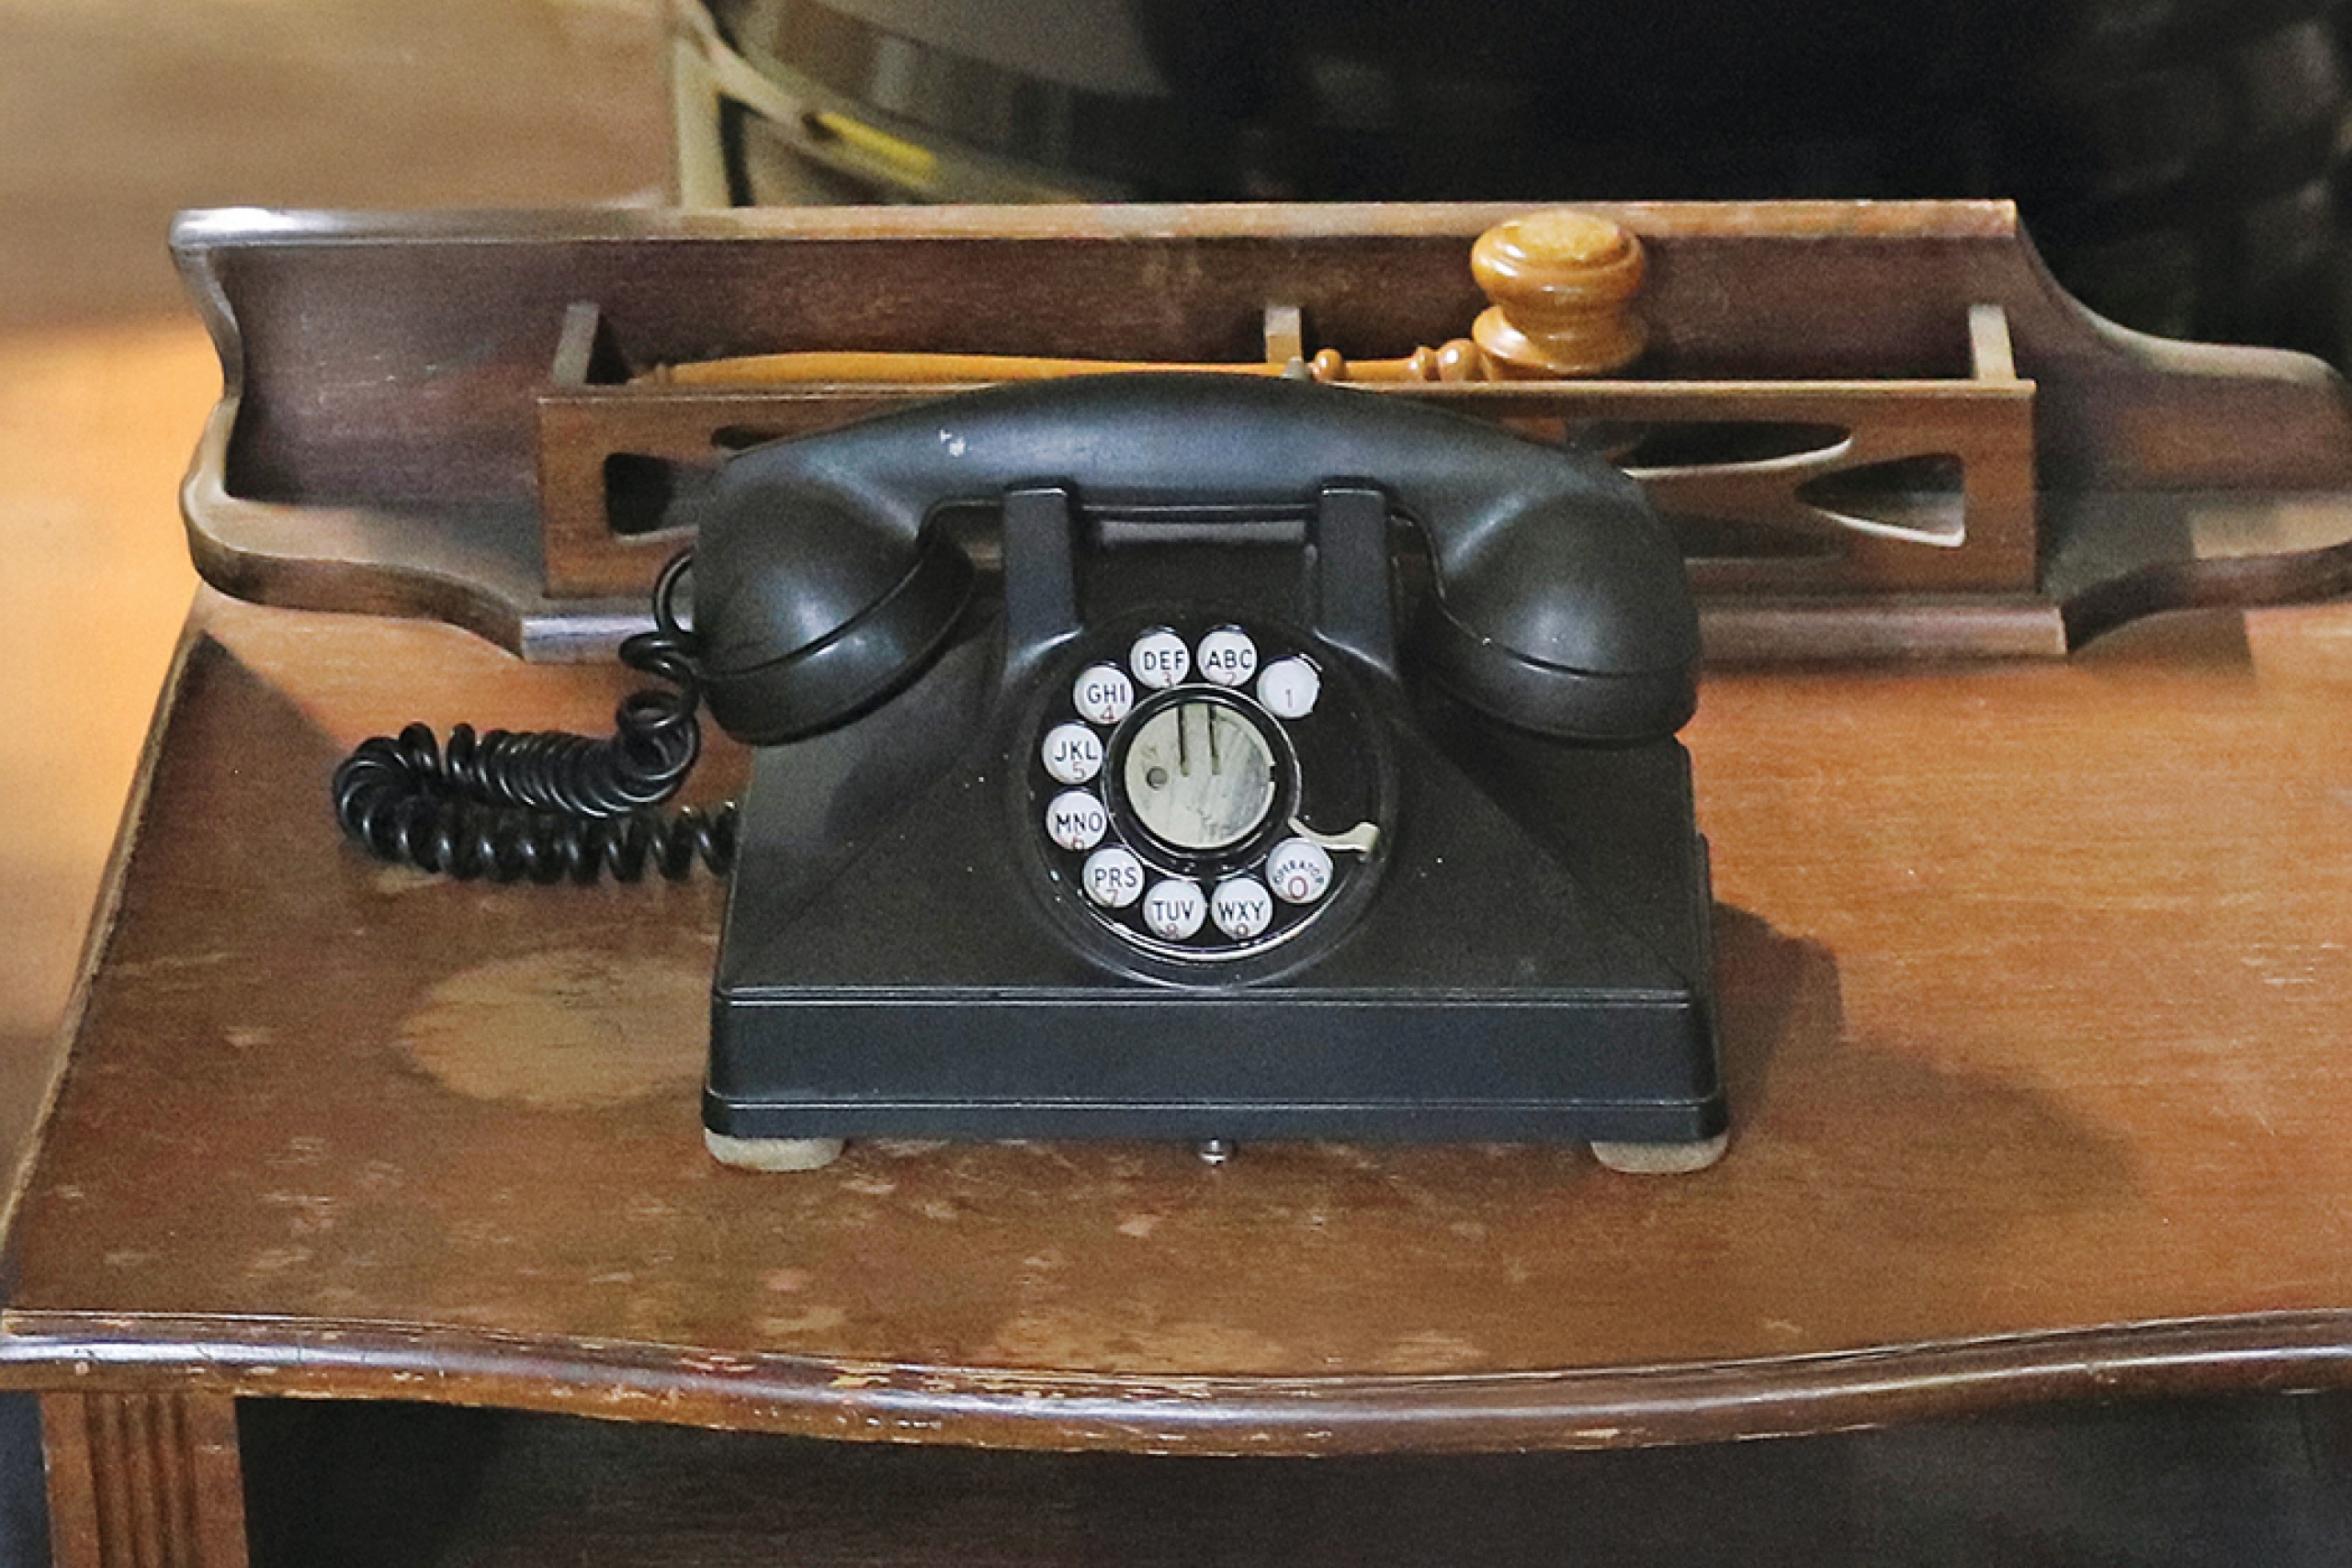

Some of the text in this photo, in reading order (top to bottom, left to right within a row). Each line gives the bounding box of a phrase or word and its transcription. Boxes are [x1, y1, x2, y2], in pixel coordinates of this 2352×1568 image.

[1143, 649, 1185, 671] DEF
[1205, 649, 1253, 670] ABC
[1087, 682, 1125, 705] GHI
[1285, 689, 1294, 708] 1
[1099, 705, 1116, 723] 4
[1055, 740, 1098, 761] JKL
[1072, 761, 1087, 781] 5
[1055, 811, 1102, 834] MNO
[1094, 866, 1137, 888] PRS
[1105, 889, 1118, 907] 7
[1151, 899, 1194, 921] TUV
[1217, 899, 1264, 921] WXY
